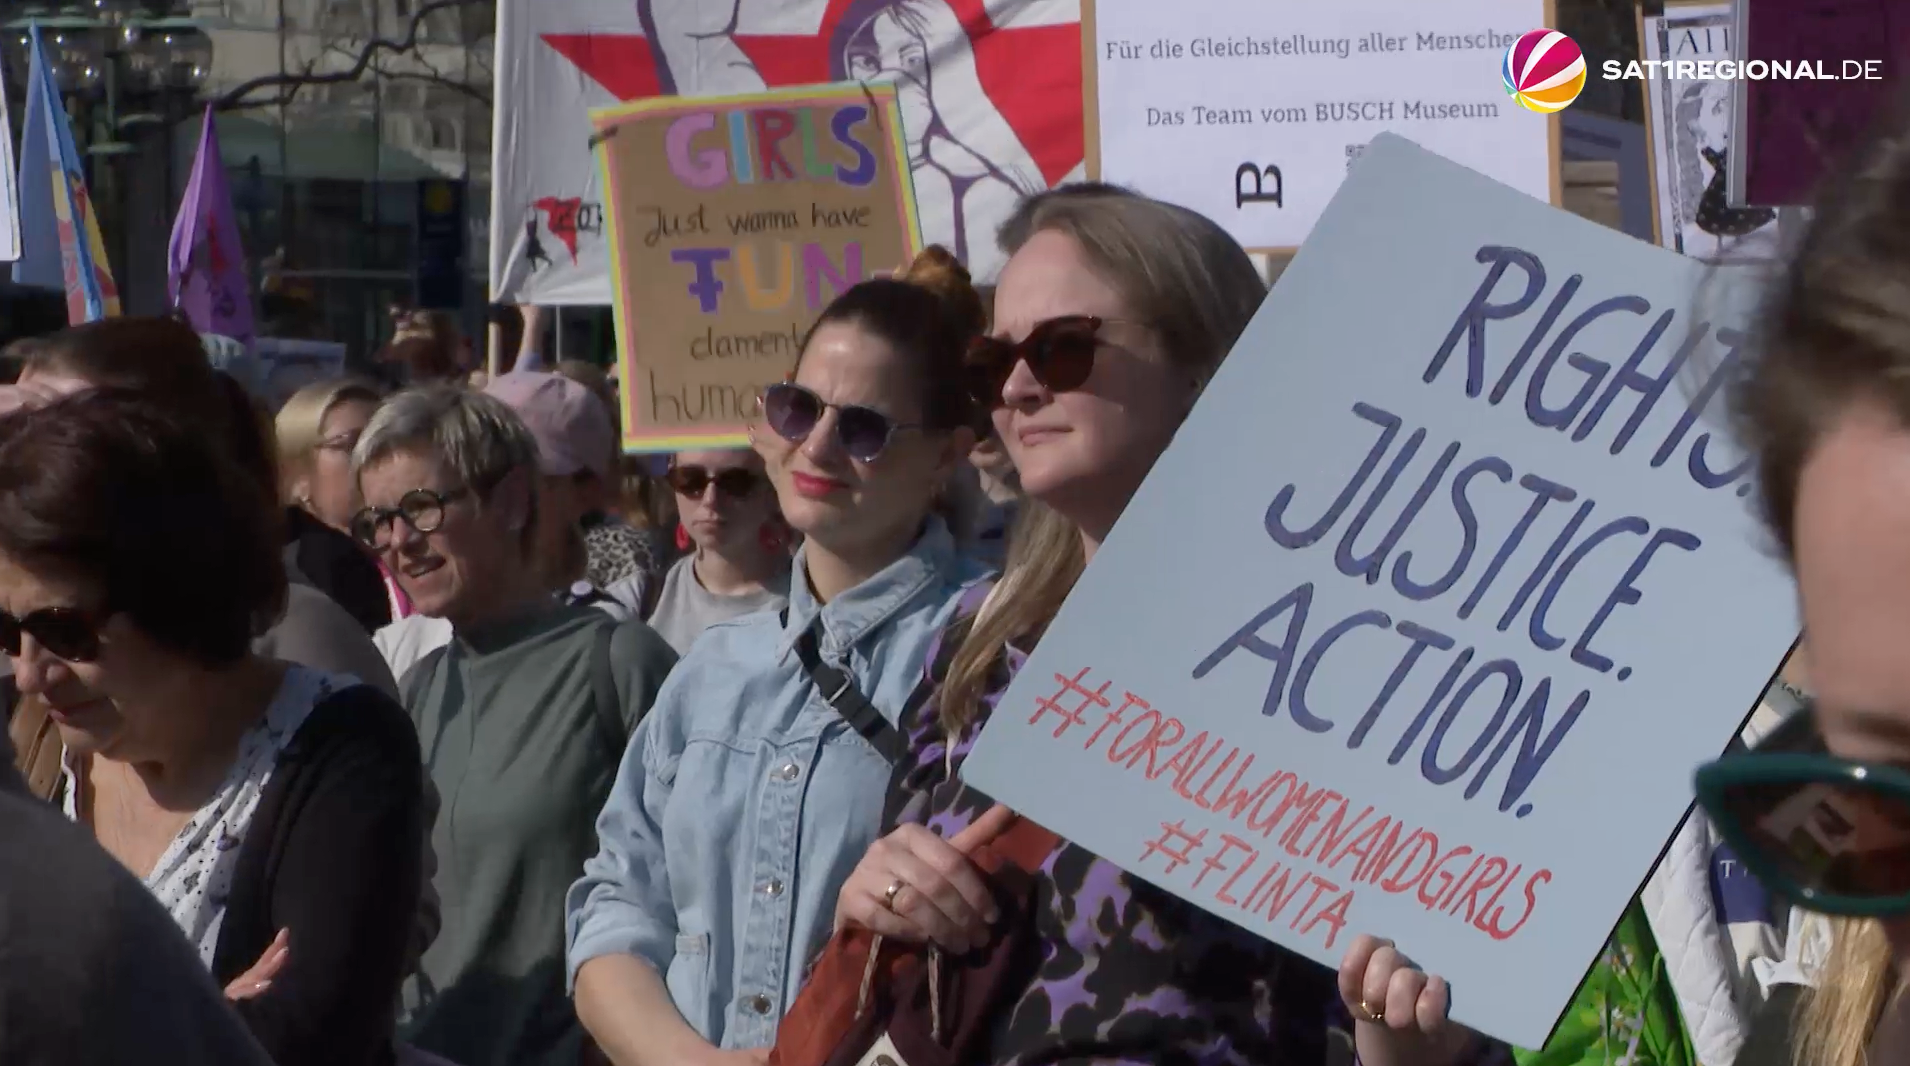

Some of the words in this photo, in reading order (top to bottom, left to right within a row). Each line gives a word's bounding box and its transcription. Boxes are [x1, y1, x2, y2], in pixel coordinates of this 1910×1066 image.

[1105, 40, 1143, 61] Für
[1150, 38, 1184, 59] die
[1190, 33, 1351, 59] Gleichstellung
[1357, 31, 1408, 53] aller
[1415, 27, 1522, 52] Mensche
[1146, 106, 1185, 127] Das
[1192, 105, 1253, 126] Team
[1260, 106, 1307, 123] vom
[1314, 101, 1395, 122] BUSCH
[1402, 100, 1500, 121] Museum
[664, 104, 878, 190] GIRLS
[1234, 160, 1283, 209] B
[727, 207, 799, 236] wanna
[810, 202, 872, 229] have
[689, 321, 803, 362] dament
[649, 367, 764, 425] huma
[1263, 401, 1702, 683] JUSTICE.
[1192, 582, 1592, 820] ACTION.
[1027, 665, 1553, 941] #FORALLWOMENANDGIRLS
[1137, 818, 1356, 949] #FLINTA
